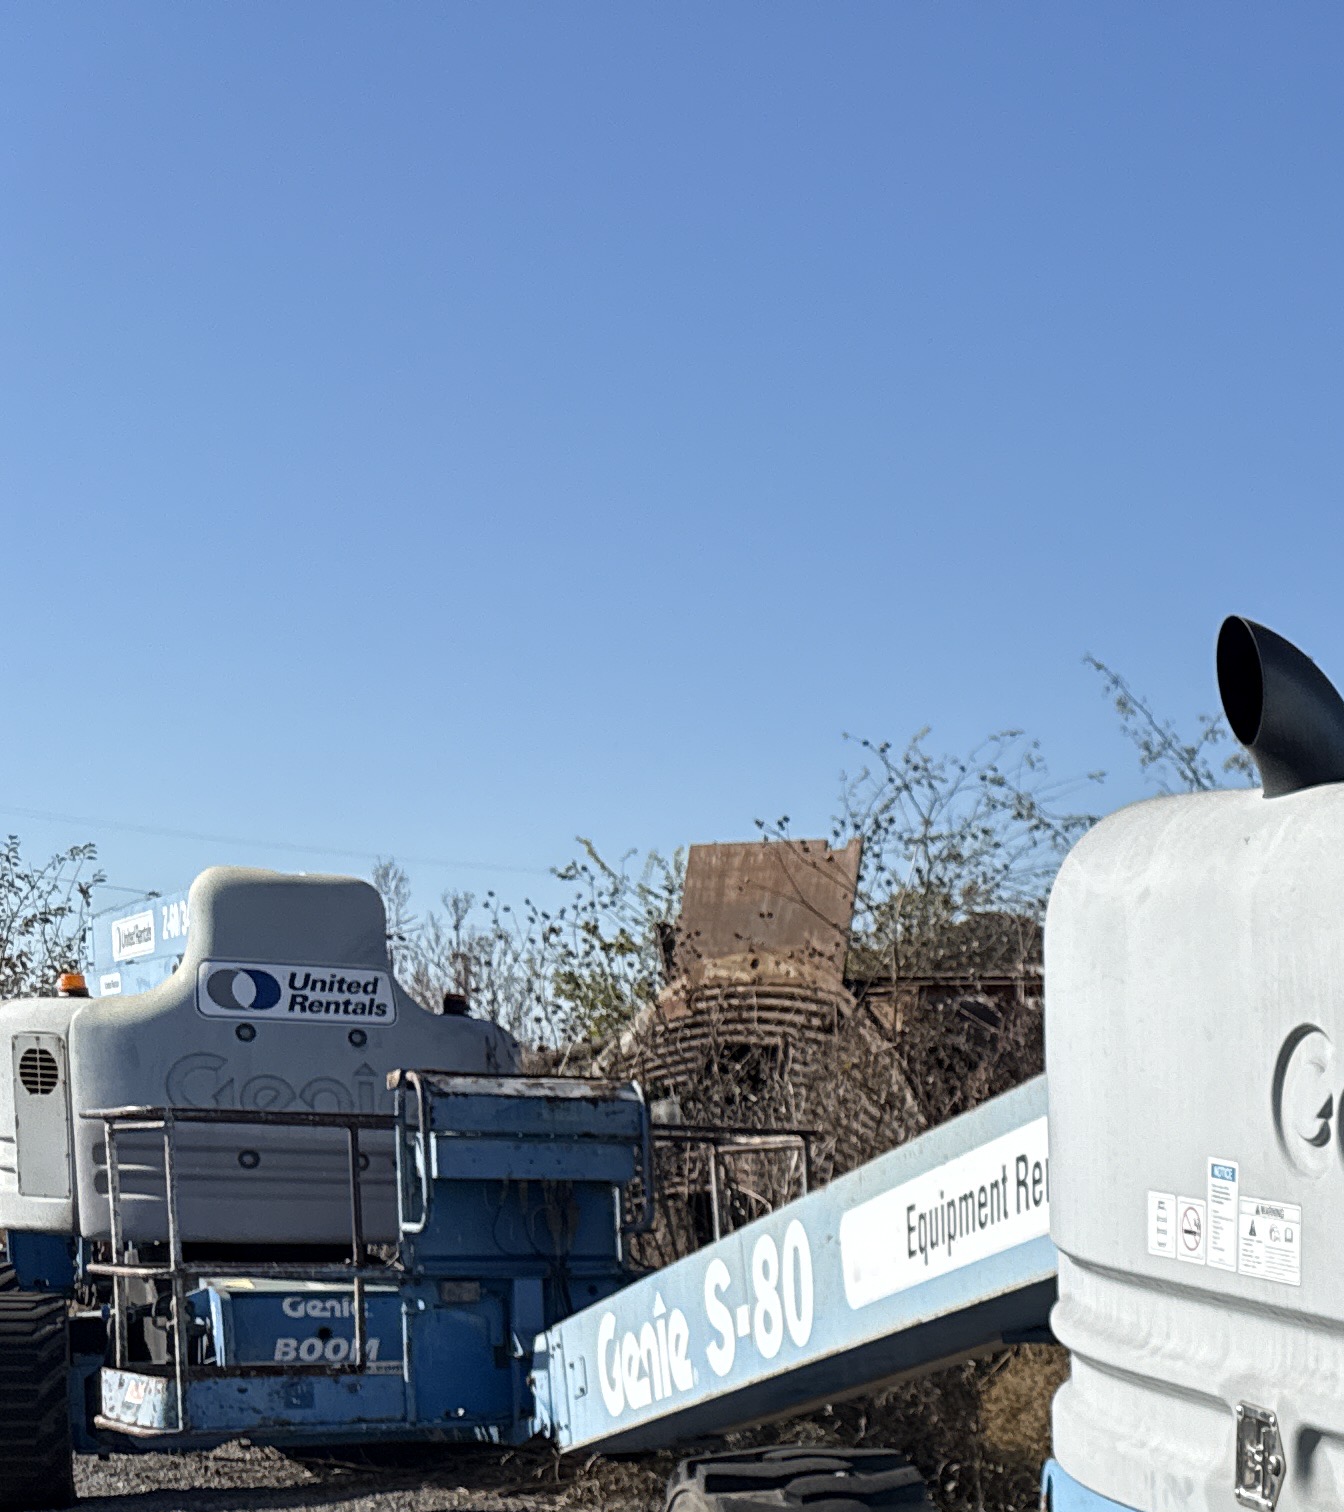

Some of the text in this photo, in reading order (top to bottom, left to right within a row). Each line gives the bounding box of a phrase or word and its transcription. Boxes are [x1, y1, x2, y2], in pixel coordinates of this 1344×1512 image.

[287, 993, 388, 1017] Rentals
[288, 971, 379, 995] United
[165, 1051, 396, 1116] Geni
[905, 1163, 1010, 1266] Equipment
[597, 1219, 814, 1417] Genie S-80
[273, 1336, 381, 1363] BOOM
